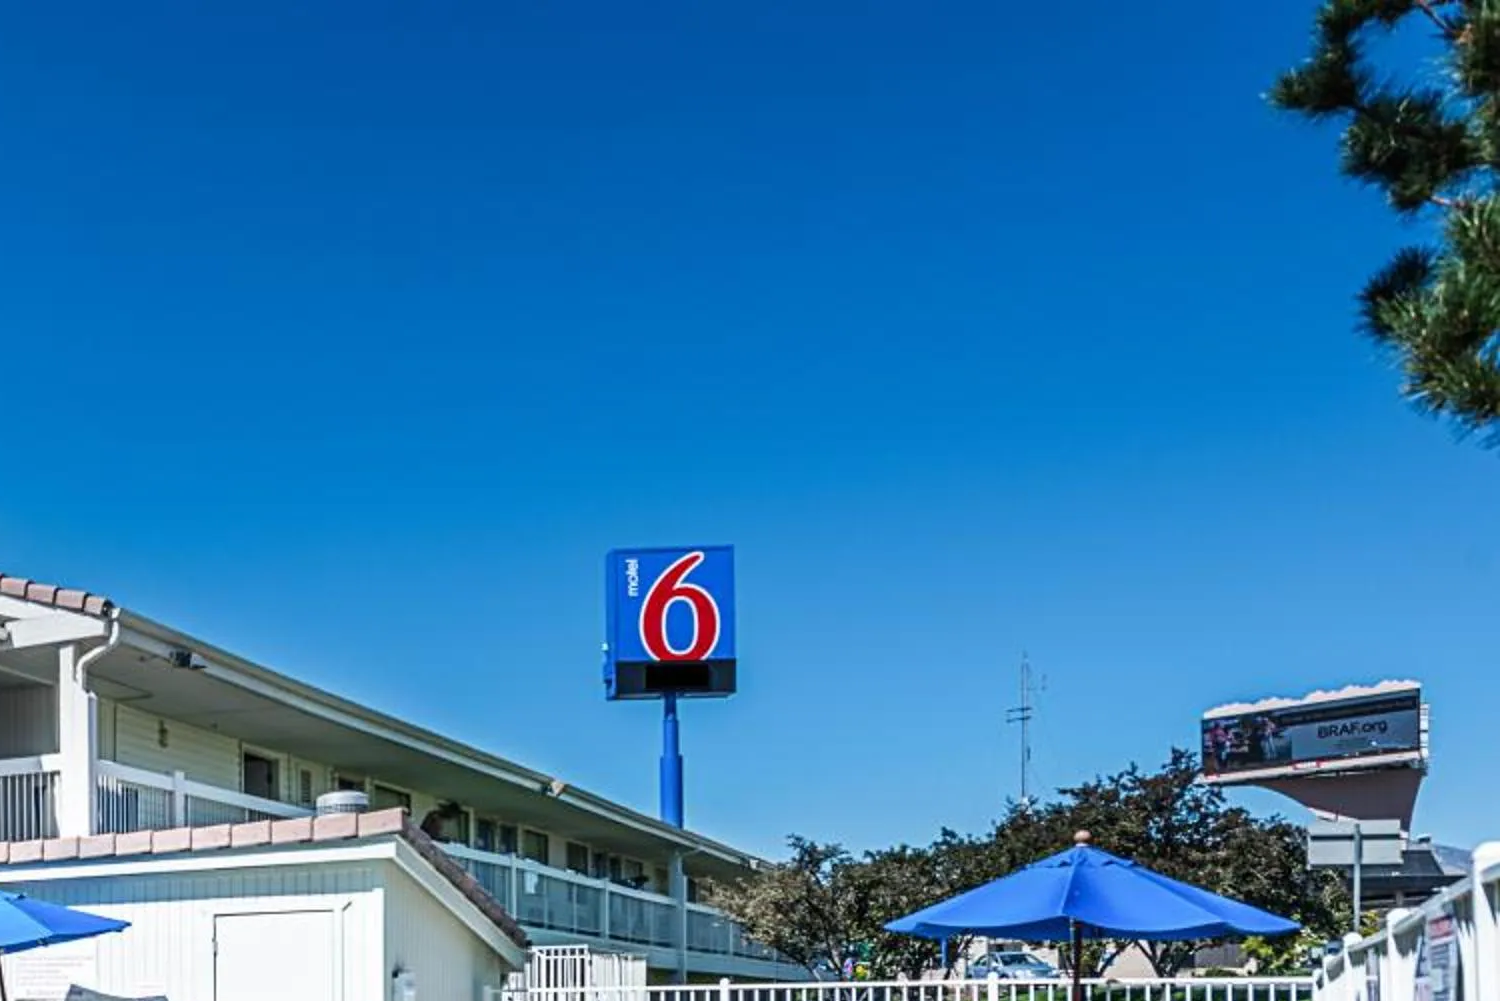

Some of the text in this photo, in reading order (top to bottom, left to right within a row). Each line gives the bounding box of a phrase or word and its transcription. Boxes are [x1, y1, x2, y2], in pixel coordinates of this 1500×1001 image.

[625, 559, 639, 597] motel
[639, 551, 720, 661] 6
[1317, 720, 1388, 739] BRAF.org
